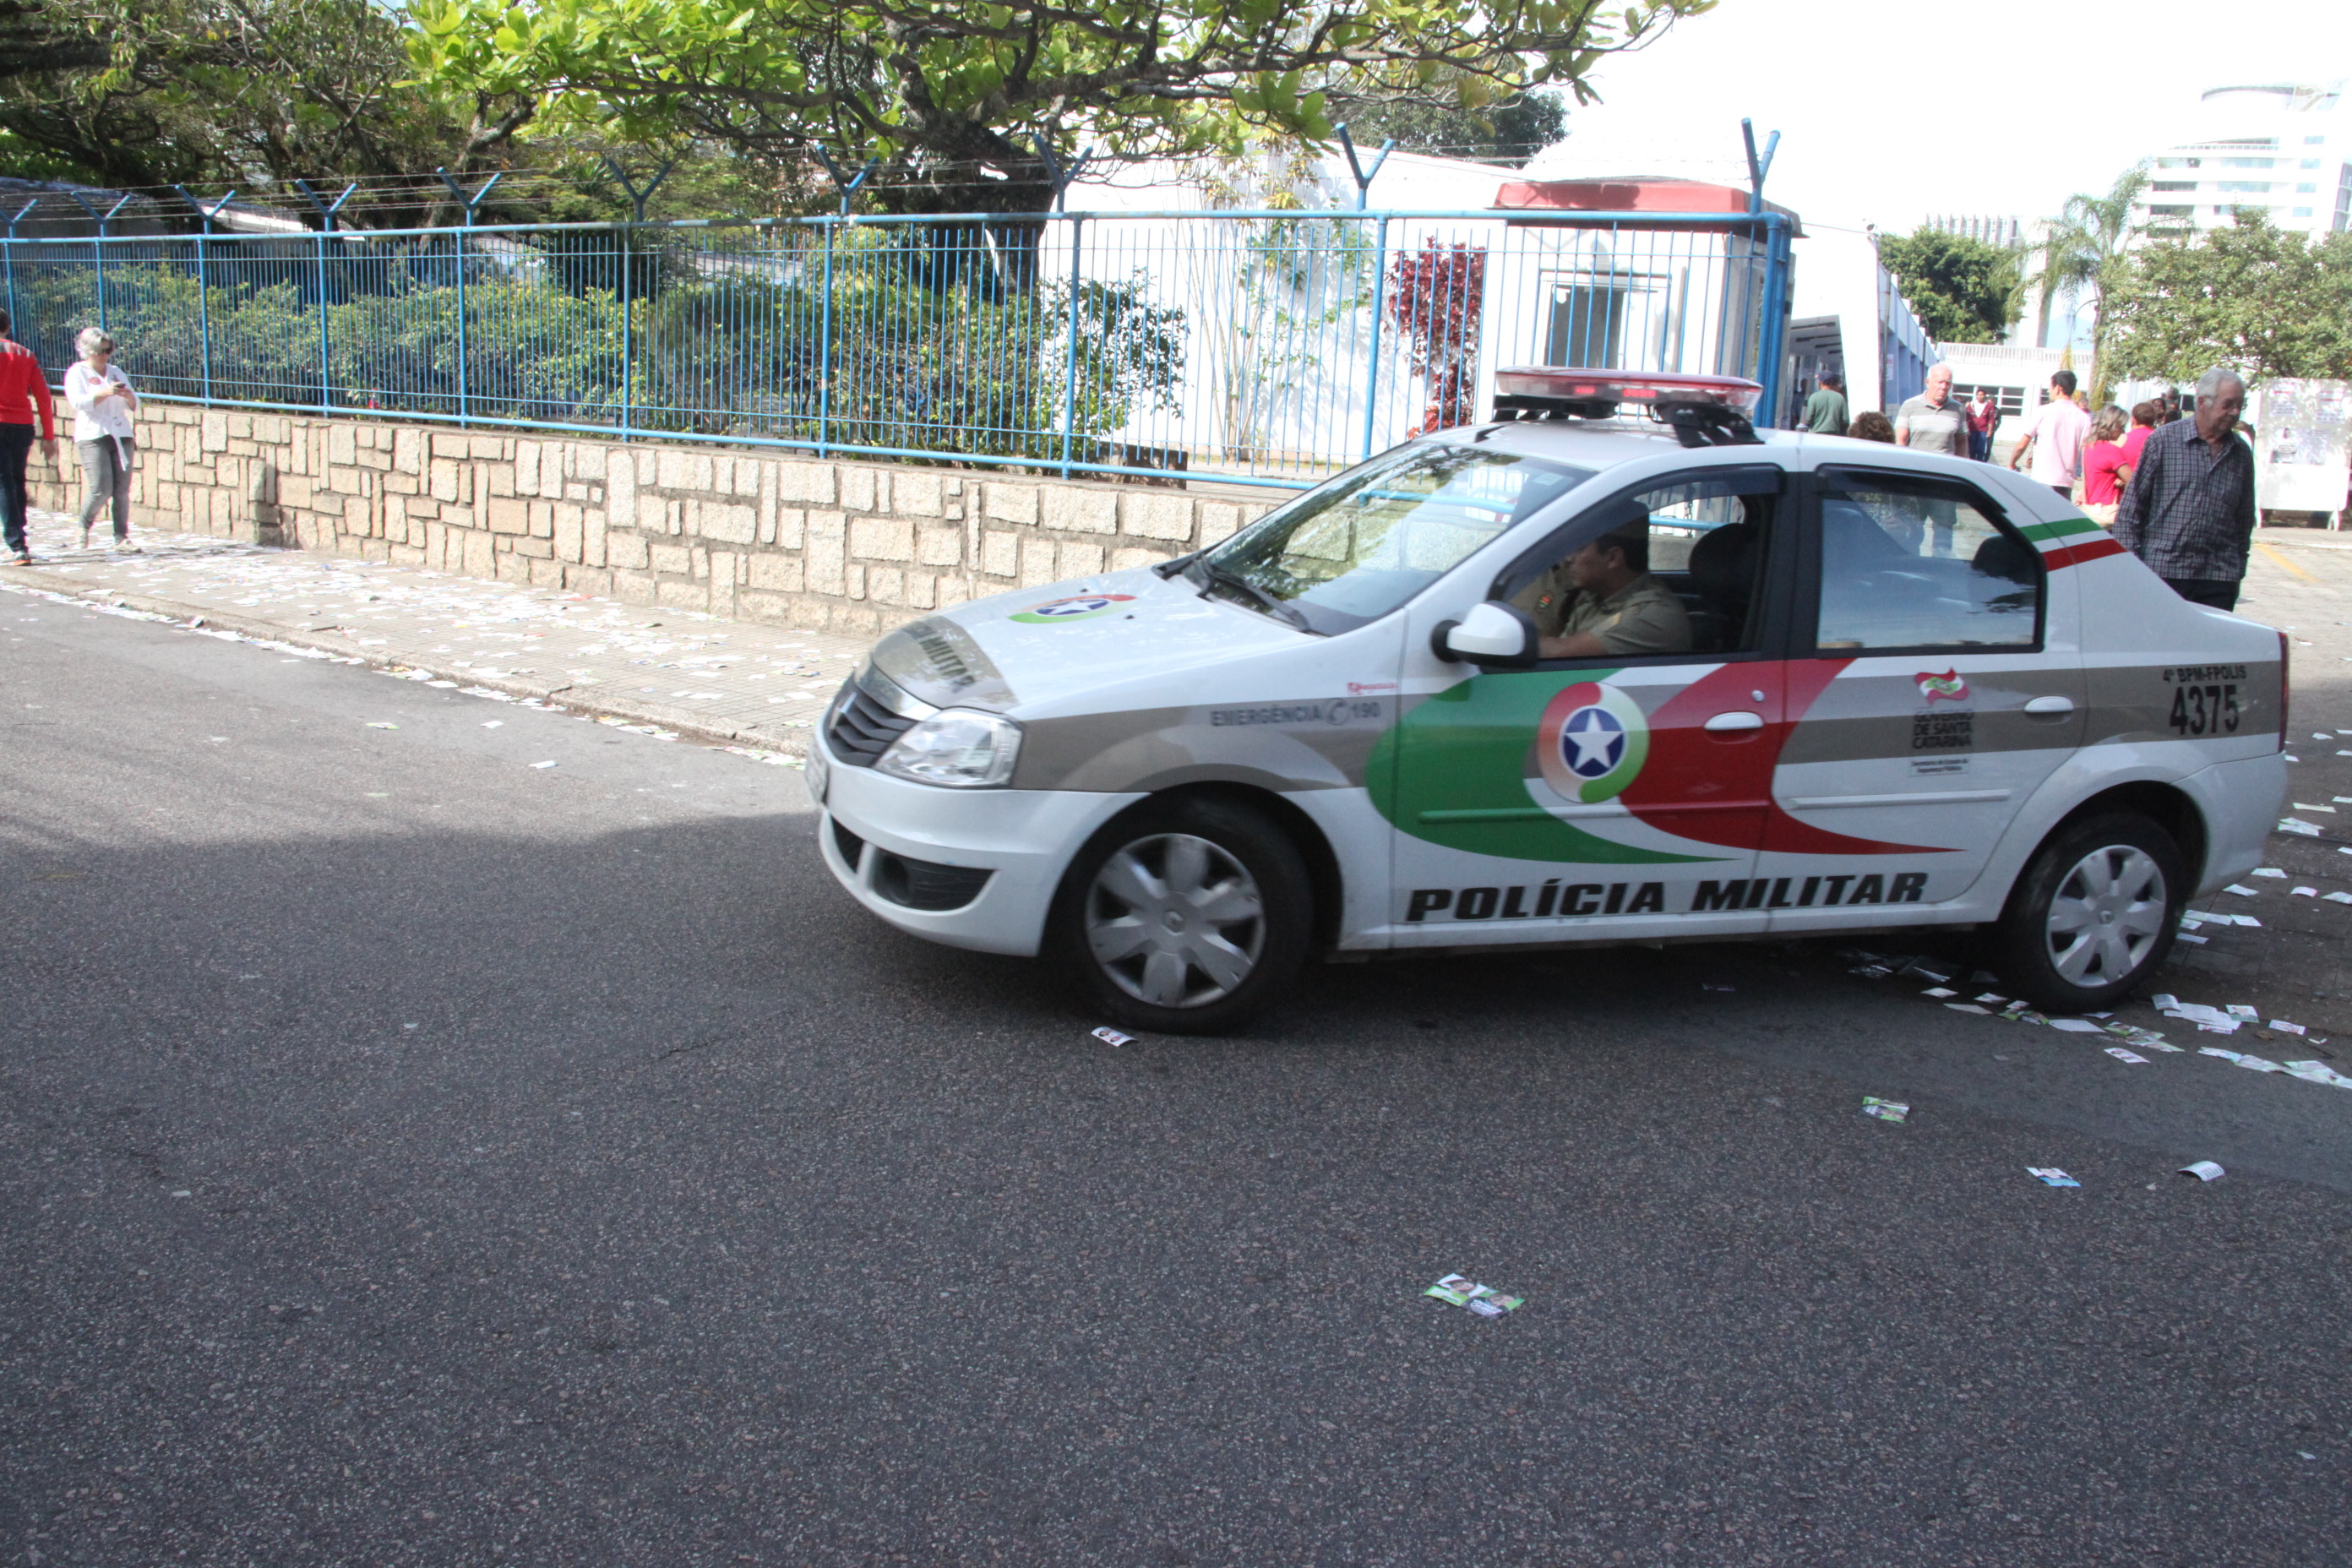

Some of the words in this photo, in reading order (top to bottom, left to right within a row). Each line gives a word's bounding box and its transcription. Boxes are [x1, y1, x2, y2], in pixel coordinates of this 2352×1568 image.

[2169, 684, 2240, 735] 4375
[1406, 878, 1664, 923] POLÍCIA
[1690, 872, 1930, 912] MILITAR
